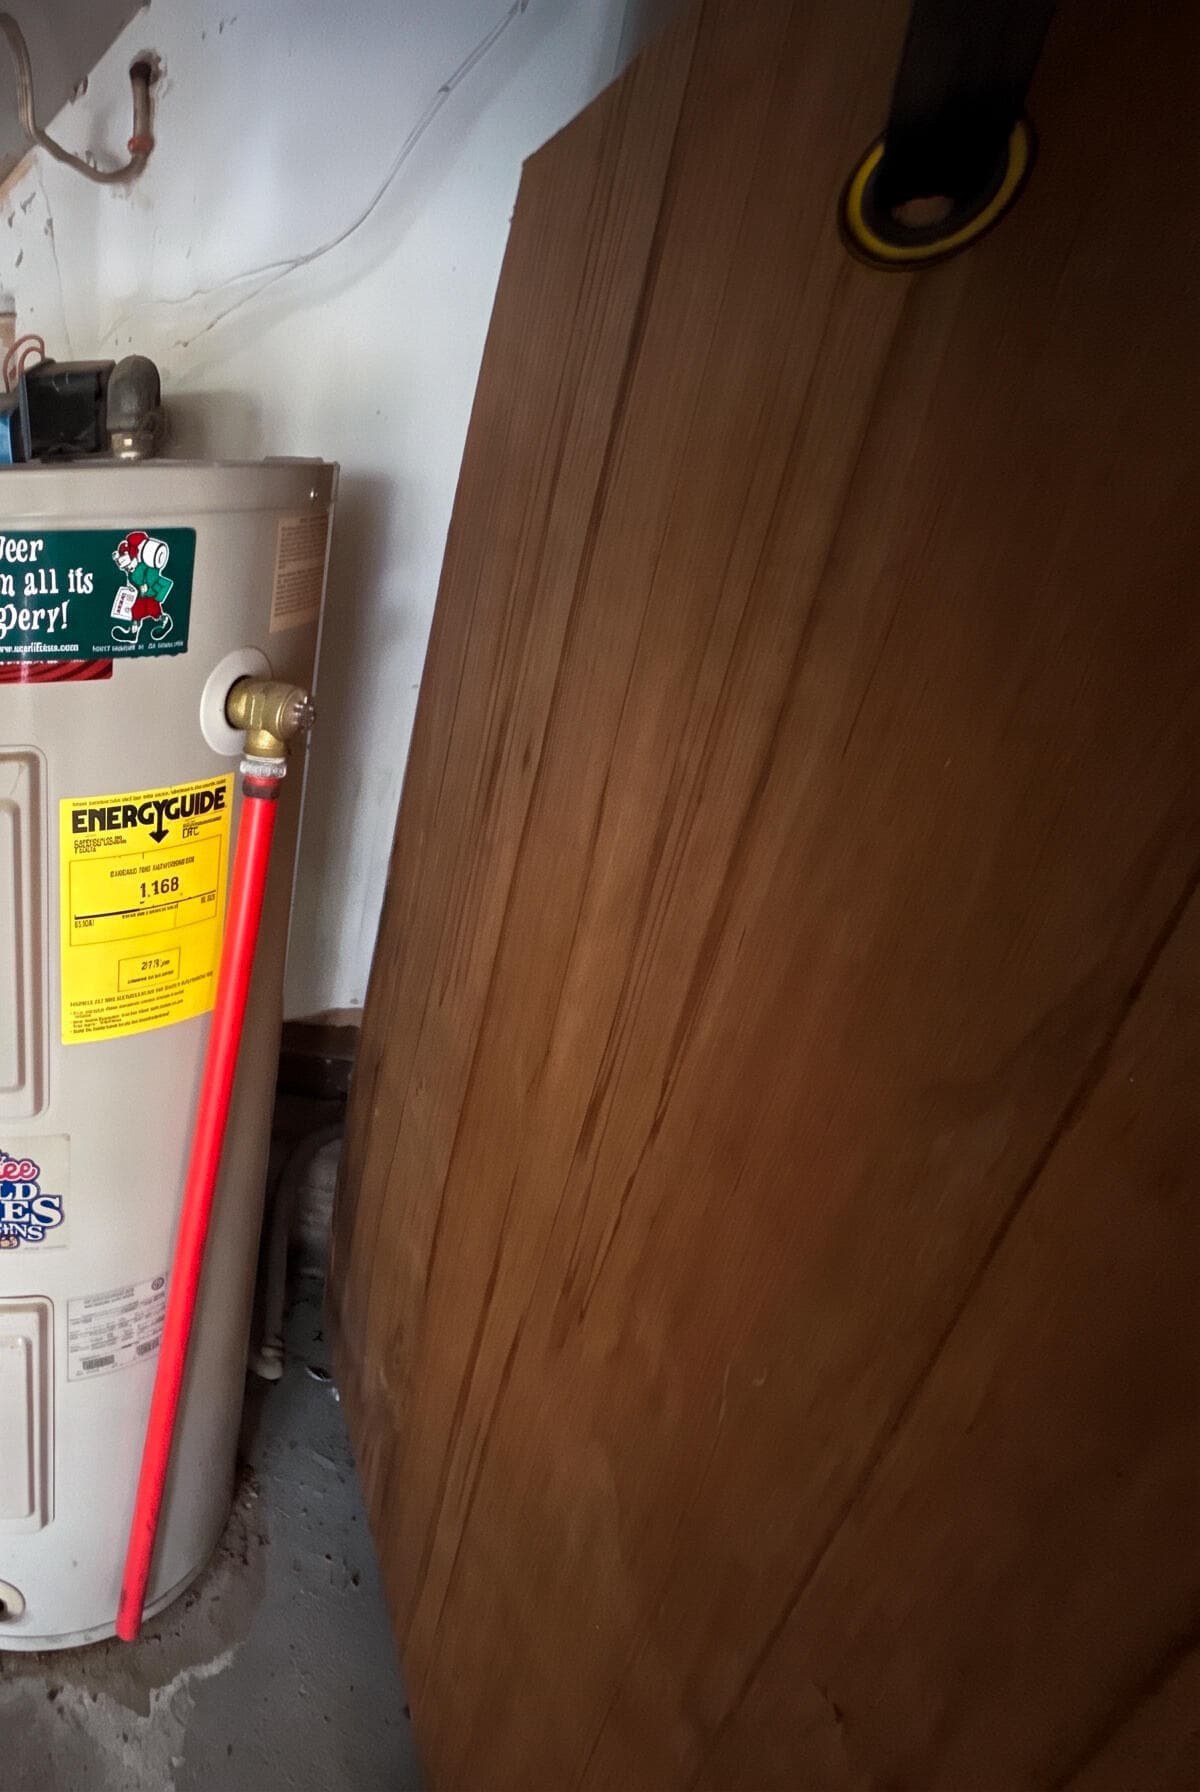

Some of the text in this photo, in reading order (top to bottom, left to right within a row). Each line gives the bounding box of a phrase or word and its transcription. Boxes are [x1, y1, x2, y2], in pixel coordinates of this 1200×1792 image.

[24, 568, 59, 597] all
[68, 567, 94, 595] its
[72, 786, 226, 834] ENERGYGUIDE
